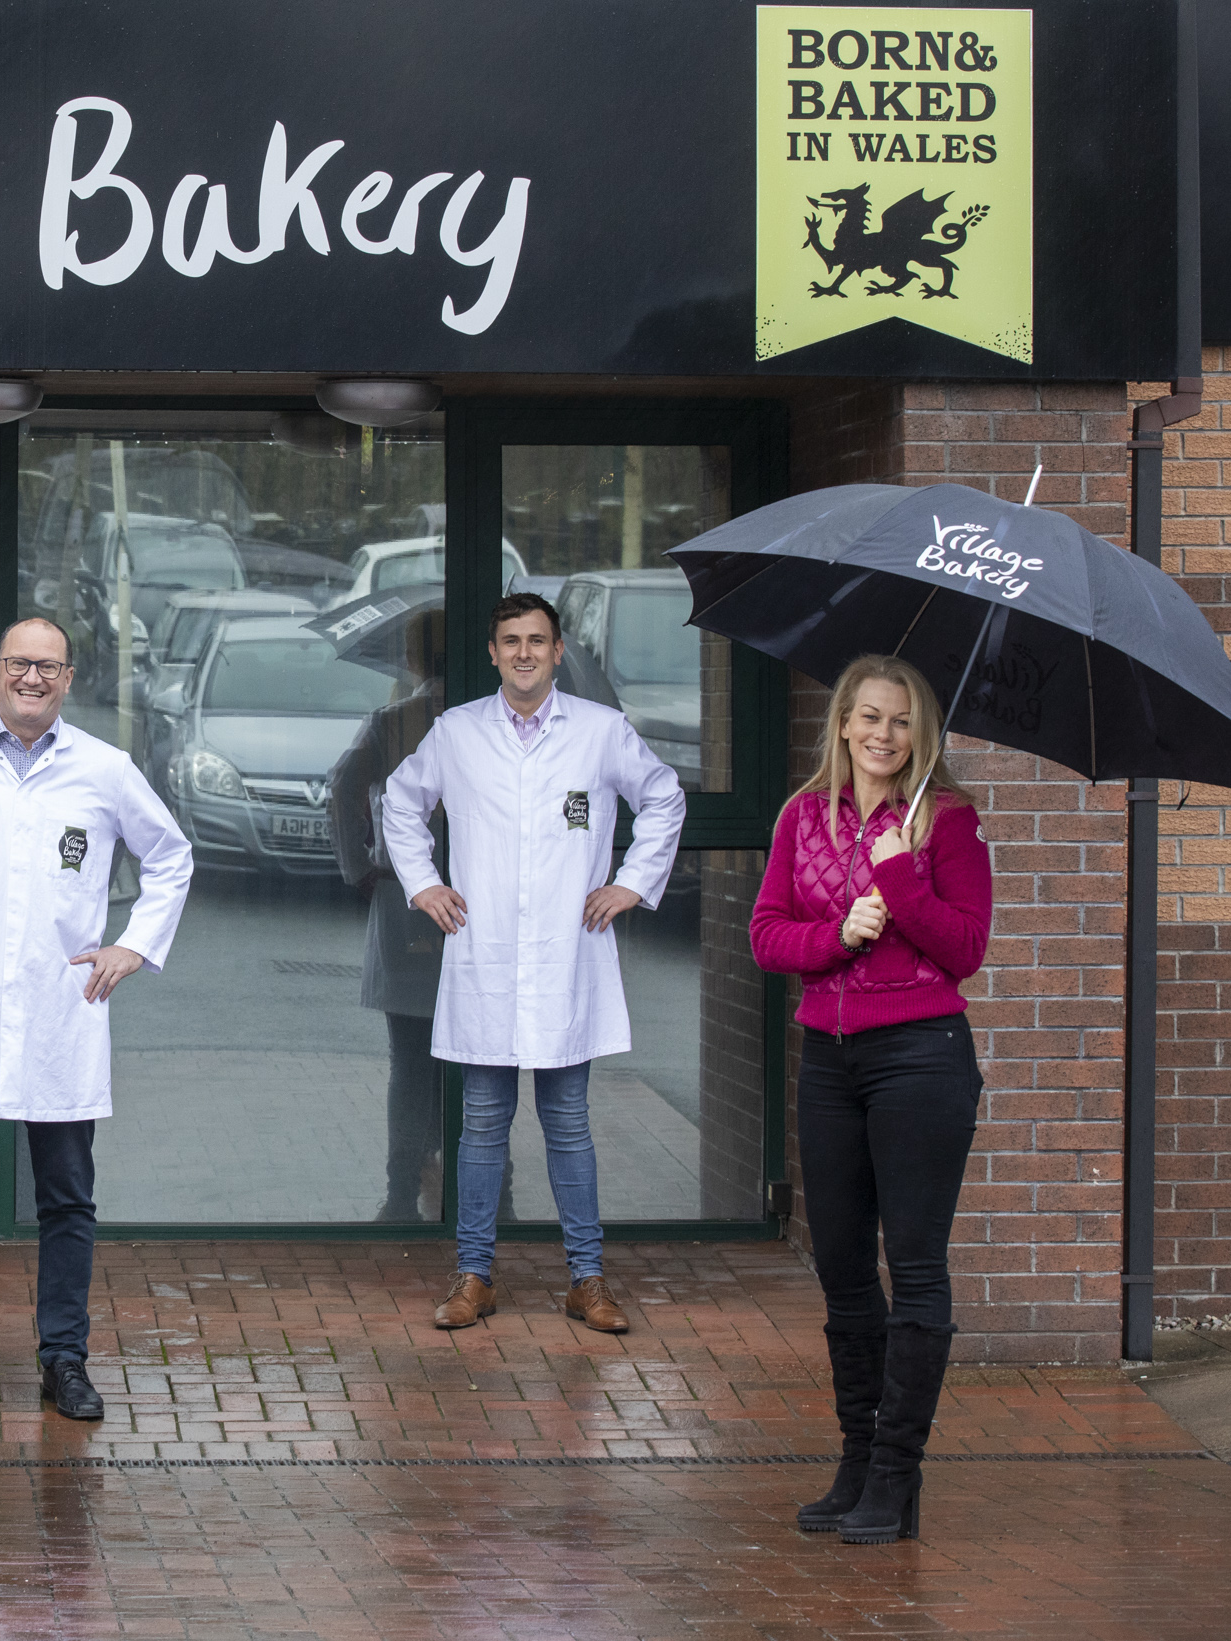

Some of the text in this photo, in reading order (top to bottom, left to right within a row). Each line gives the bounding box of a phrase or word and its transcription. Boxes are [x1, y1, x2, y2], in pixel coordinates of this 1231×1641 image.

[787, 29, 998, 72] BORN&
[787, 80, 997, 122] BAKED
[786, 132, 997, 164] IN WALES
[39, 96, 531, 335] Bakery
[933, 515, 1043, 575] Village
[916, 545, 1029, 599] Bakery
